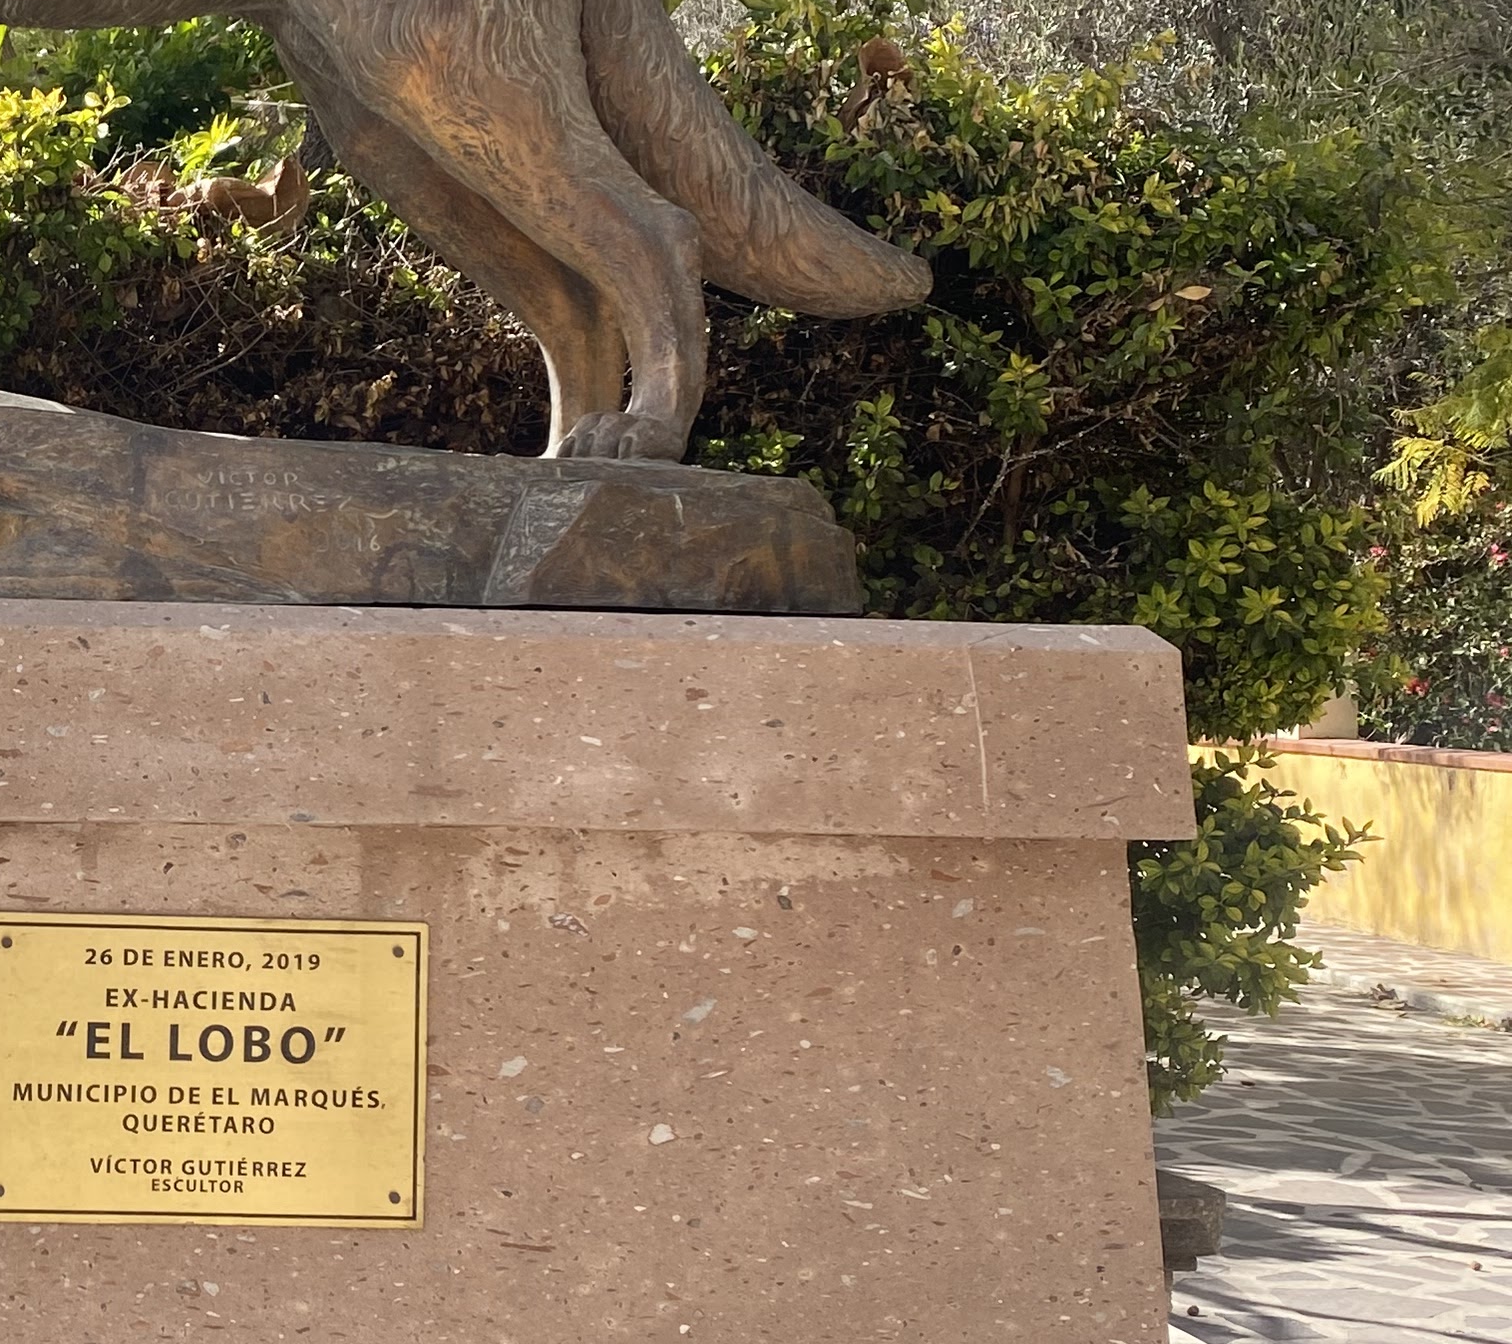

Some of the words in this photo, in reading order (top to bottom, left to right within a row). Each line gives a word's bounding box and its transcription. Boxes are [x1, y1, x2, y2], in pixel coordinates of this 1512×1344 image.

[84, 948, 113, 966] 26
[123, 948, 154, 967] DE
[163, 950, 252, 972] ENERO,
[261, 952, 321, 971] 2019
[105, 987, 297, 1012] EX-HACIENDA
[55, 1020, 145, 1061] “EL
[169, 1023, 347, 1065] LOBO”
[12, 1082, 157, 1104] MUNICIPIO
[168, 1086, 201, 1105] DE
[211, 1087, 240, 1106] EL
[250, 1085, 386, 1111] MARQUÉS,
[122, 1111, 276, 1135] QUERÉTARO
[89, 1154, 172, 1175] VÍCTOR
[181, 1155, 308, 1178] GUTIÉRREZ
[151, 1177, 244, 1194] ESCULTOR
